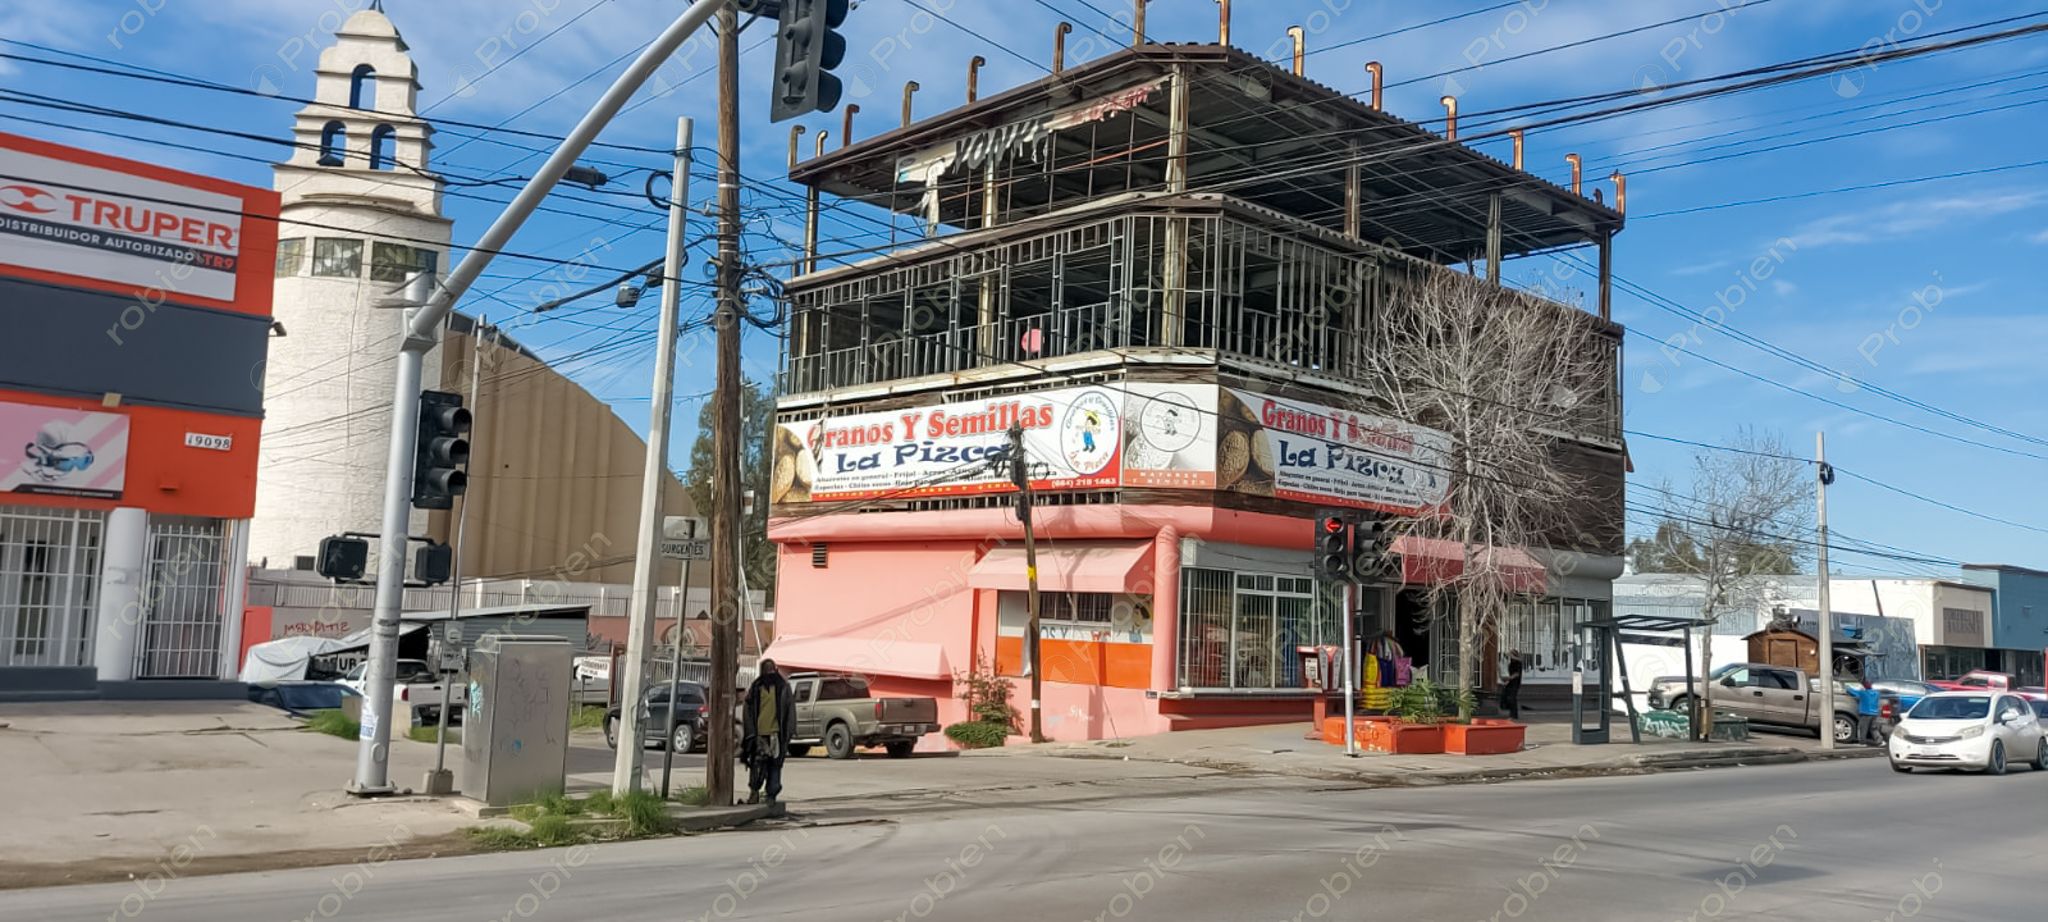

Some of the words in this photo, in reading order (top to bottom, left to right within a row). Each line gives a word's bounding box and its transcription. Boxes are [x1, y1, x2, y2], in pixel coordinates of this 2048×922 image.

[65, 194, 236, 250] TRUPER
[104, 237, 195, 262] AUTORIZADO
[900, 412, 922, 441] Y
[926, 400, 1054, 440] Semillas
[1262, 399, 1327, 437] Granos
[188, 435, 230, 449] 19098
[1279, 440, 1317, 468] La
[835, 452, 881, 474] La
